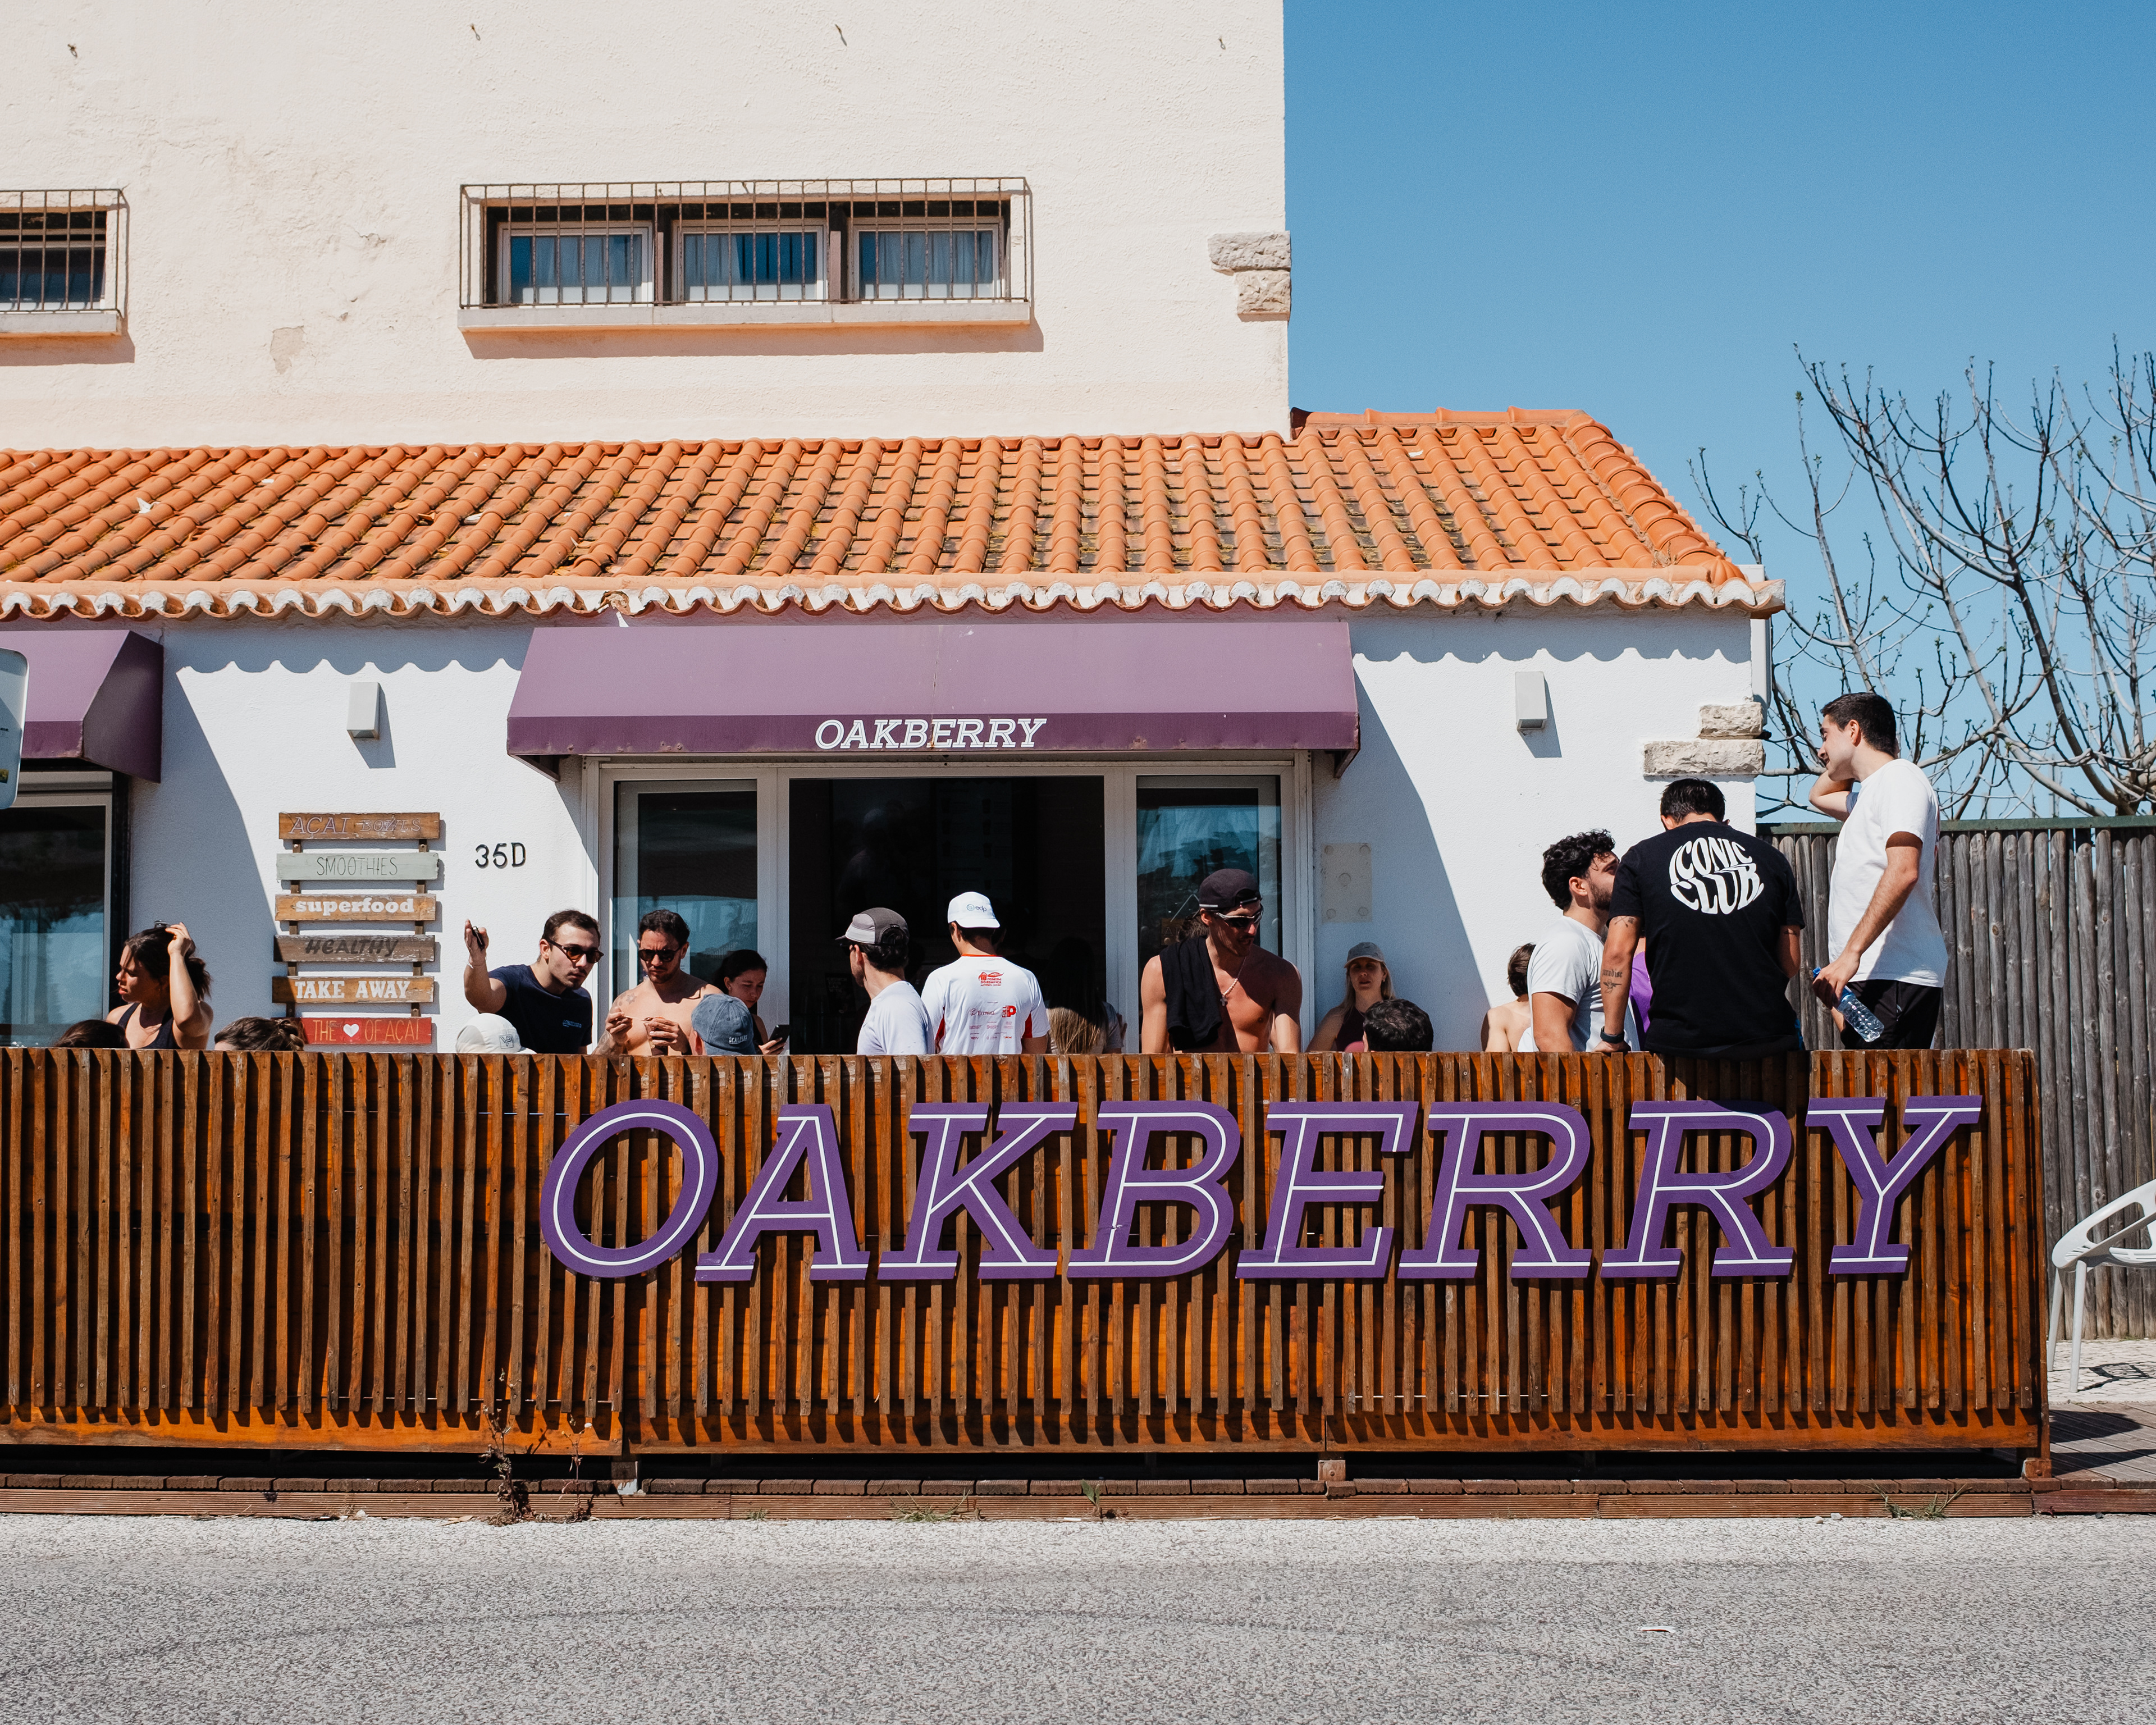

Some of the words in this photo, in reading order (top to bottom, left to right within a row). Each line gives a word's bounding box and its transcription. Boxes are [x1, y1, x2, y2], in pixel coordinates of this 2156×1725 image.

[815, 718, 1047, 750] OAKBERRY
[359, 818, 422, 832] BOWLS
[317, 857, 398, 876] SMOOTHIES
[475, 842, 526, 869] 35D
[1669, 837, 1753, 885] ICONIC
[1670, 863, 1764, 915] CLUB
[295, 897, 415, 916] superfood
[305, 939, 399, 957] HEALTHY
[295, 980, 345, 999] TAKE
[355, 980, 411, 999] AWAY
[313, 1020, 336, 1042] THE
[365, 1020, 382, 1041] OF
[540, 1095, 1983, 1282] OAKBERRY
